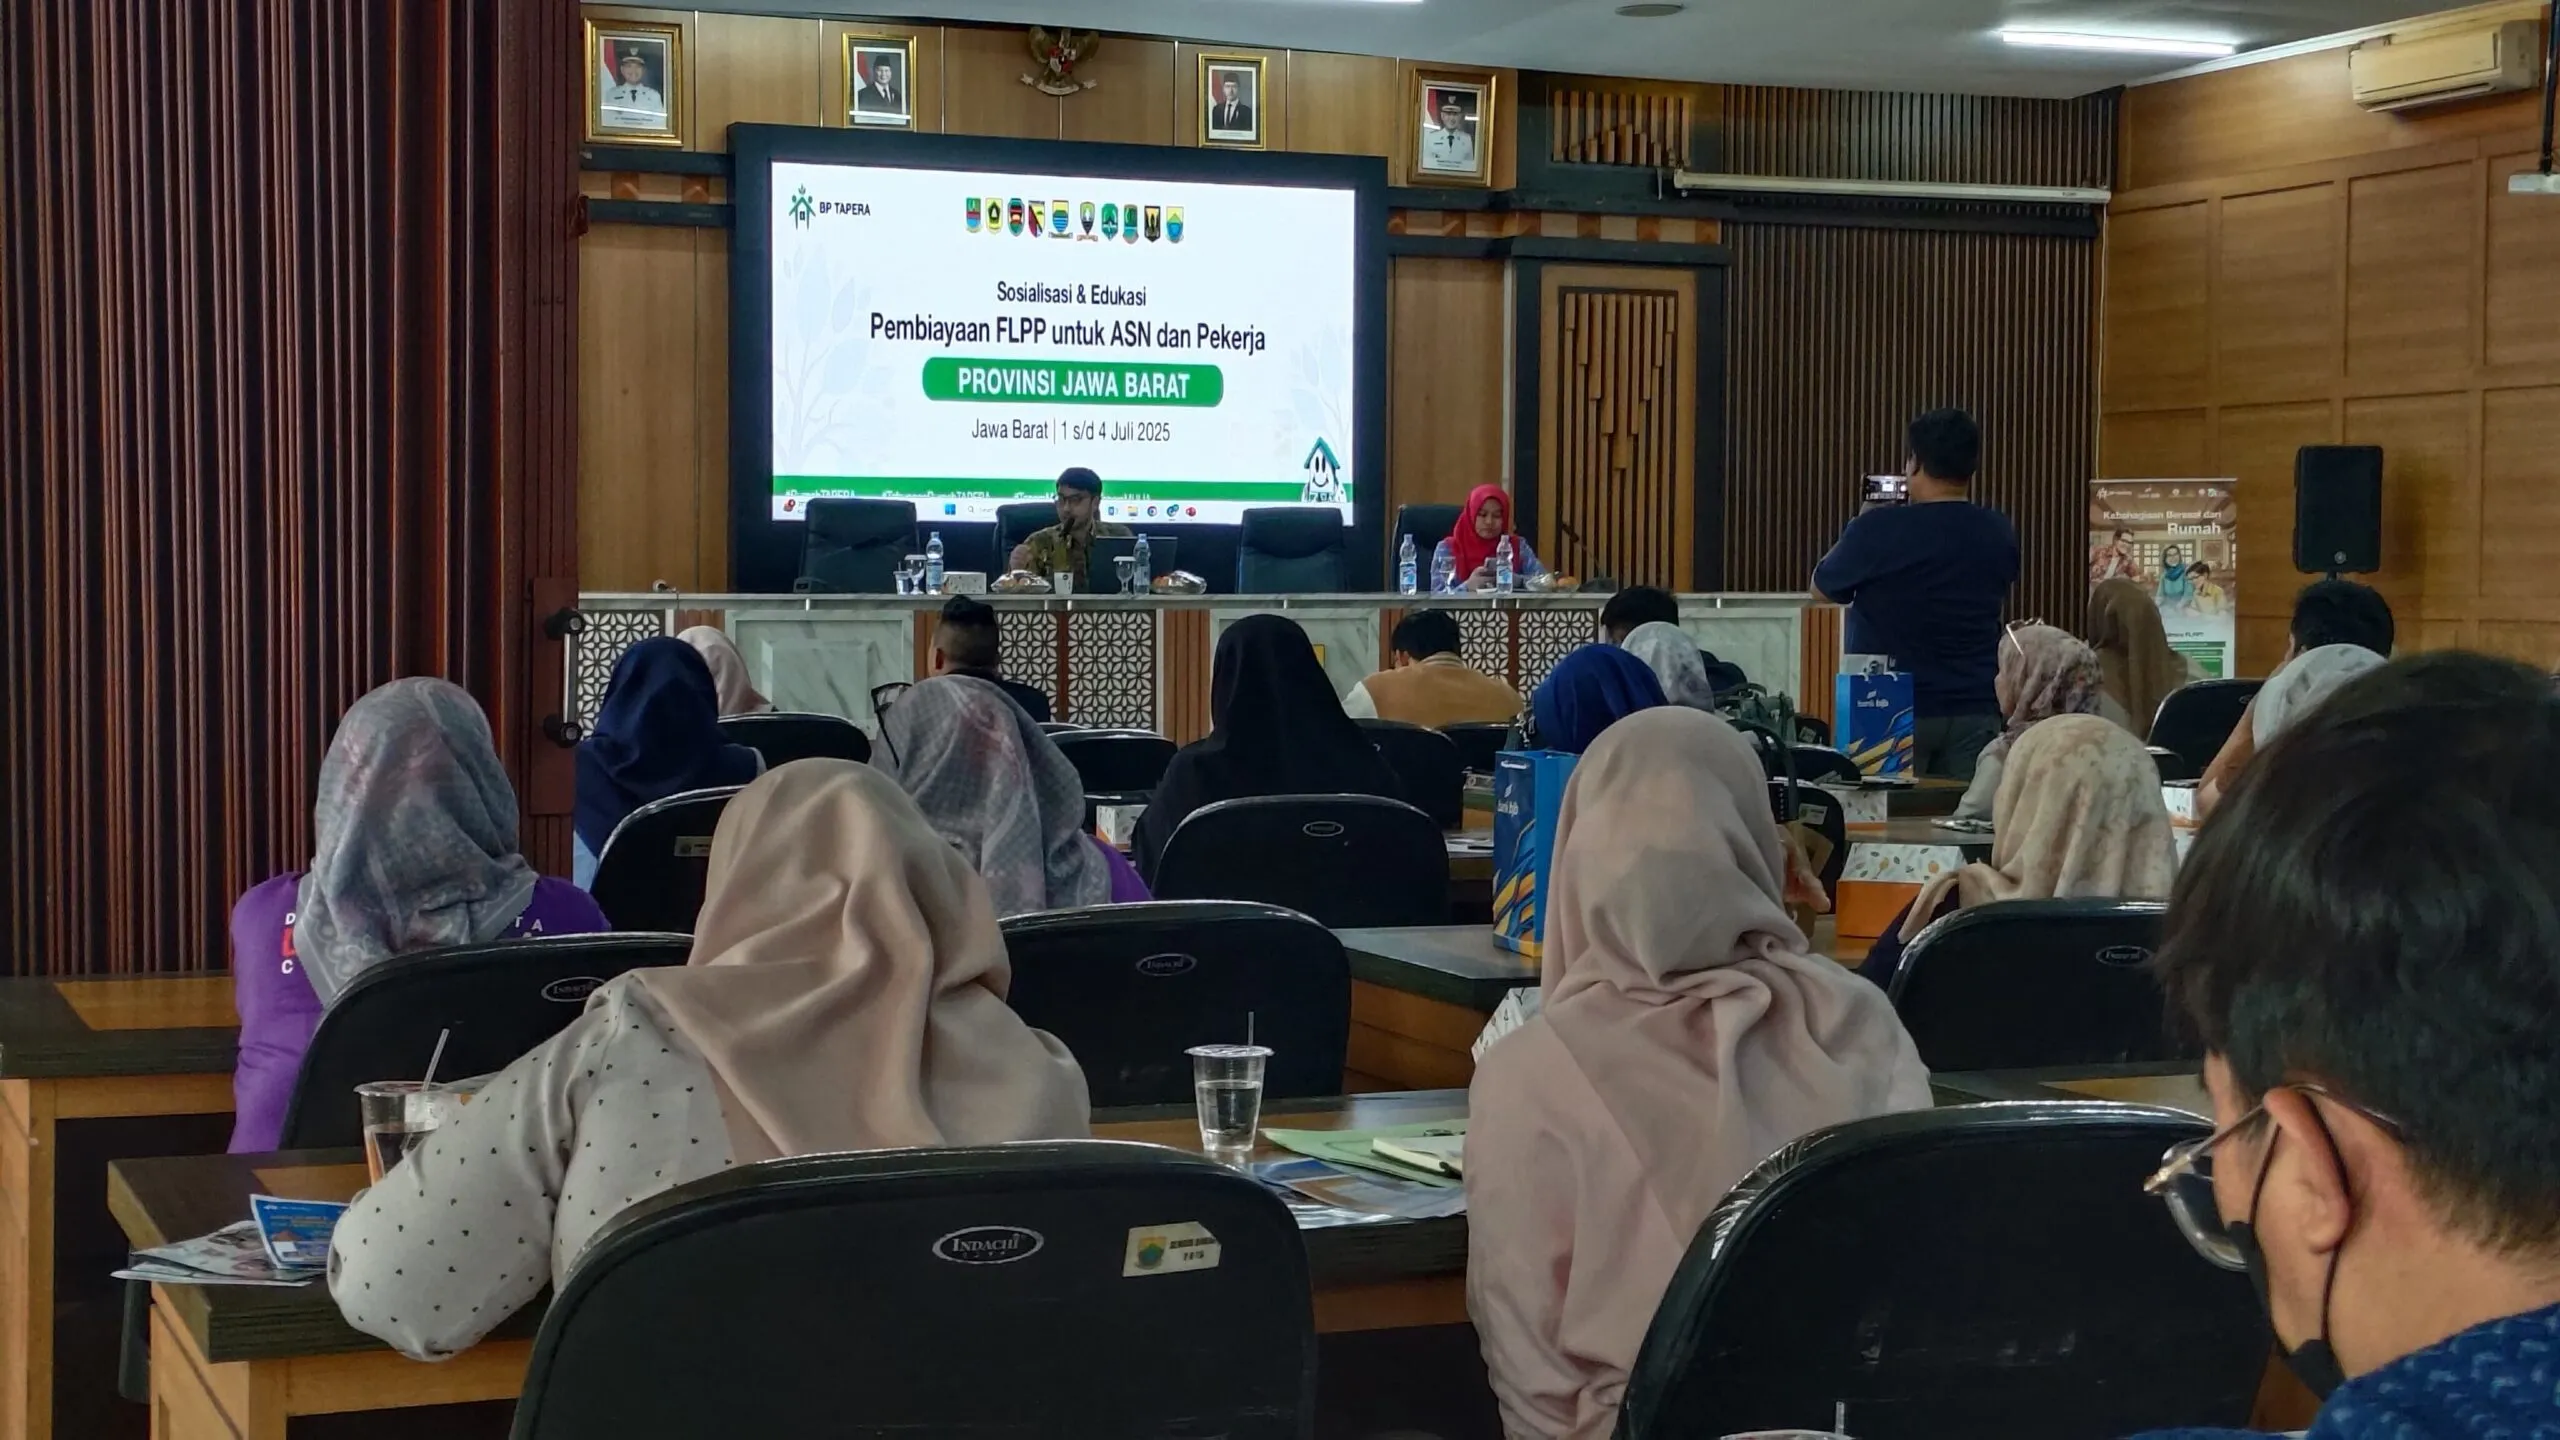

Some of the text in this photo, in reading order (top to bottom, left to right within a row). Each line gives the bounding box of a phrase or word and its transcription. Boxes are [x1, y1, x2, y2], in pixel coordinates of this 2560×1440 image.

[819, 201, 871, 216] BP TAPERA
[997, 280, 1146, 306] Sosialisasi & Edukasi
[870, 312, 1265, 356] Pembiayaan FLPP untuk ASN dan Pekerja
[958, 366, 1190, 400] PROVINSI JAWA BARAT
[971, 418, 1170, 442] Jawa Barat 1 s/d 4 Juli 2025
[2167, 522, 2222, 536] Rumah
